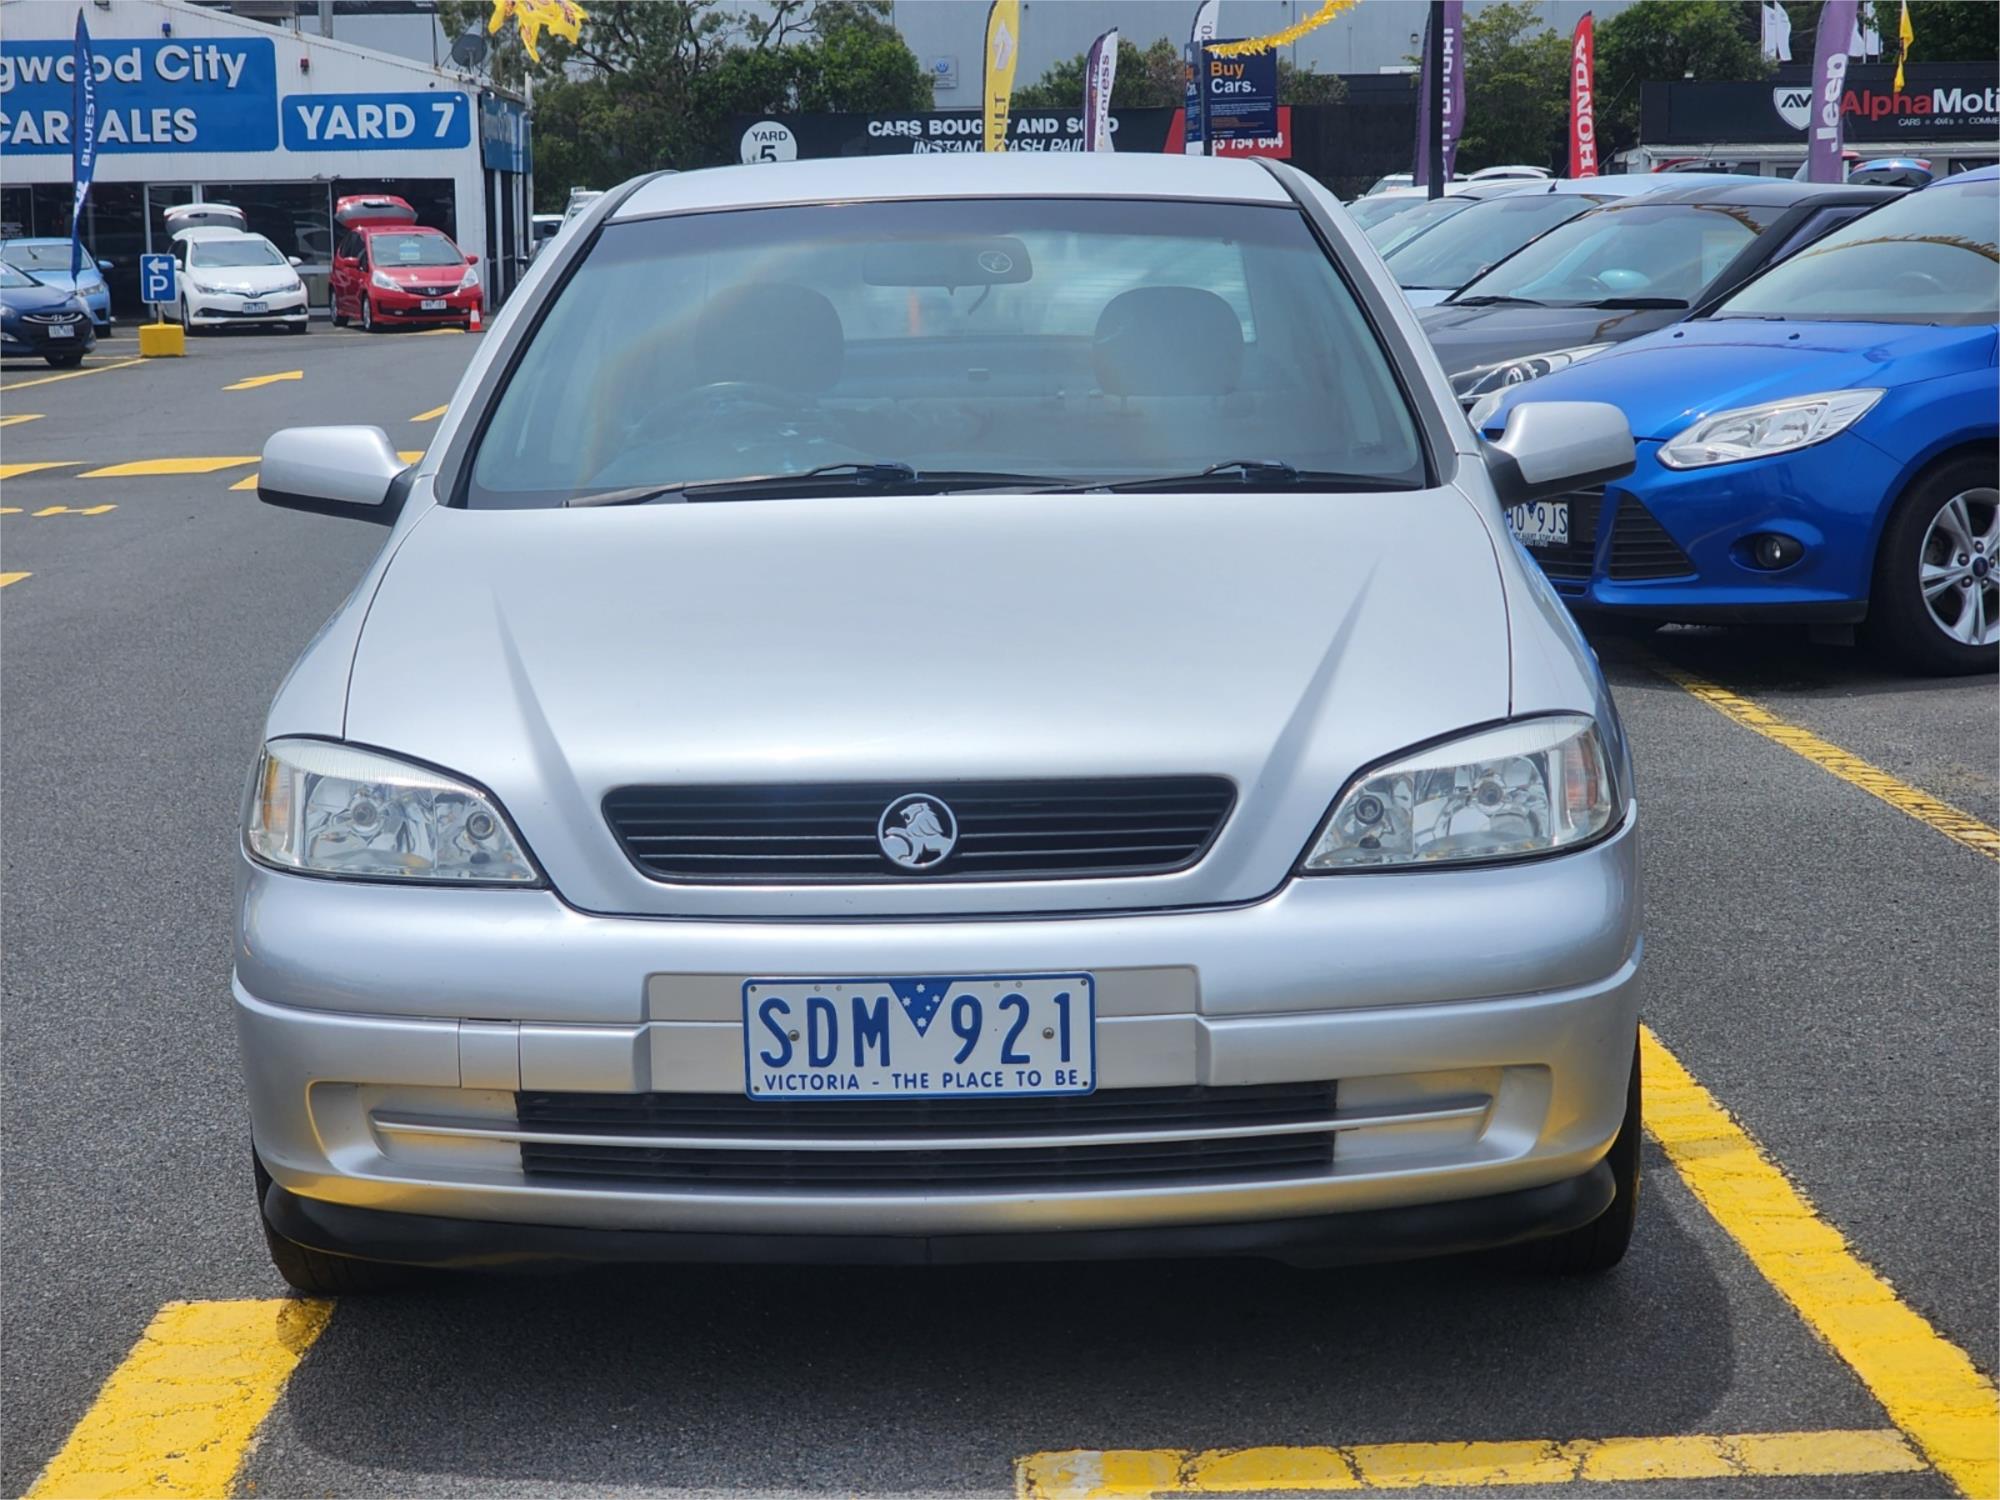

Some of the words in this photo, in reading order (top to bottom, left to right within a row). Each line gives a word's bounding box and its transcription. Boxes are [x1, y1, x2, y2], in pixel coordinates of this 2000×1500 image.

[155, 45, 247, 89] City
[1210, 61, 1245, 79] Buy
[1210, 78, 1257, 94] Cars.
[80, 48, 97, 167] BLUESTO
[1575, 34, 1595, 170] HONDA
[296, 103, 417, 141] YARD
[431, 102, 456, 138] 7
[868, 119, 922, 136] CARS
[928, 117, 1012, 135] BOUG
[1016, 118, 1059, 134] AND
[751, 130, 788, 142] YARD
[1004, 138, 1046, 152] ASH
[760, 144, 777, 163] 5
[150, 275, 169, 299] P
[1537, 506, 1568, 534] 9JS
[759, 996, 891, 1068] SDM
[951, 992, 1071, 1065] 921
[764, 1074, 861, 1091] VICTORIA
[892, 1073, 930, 1089] THE
[943, 1070, 1004, 1089] PLACE
[1016, 1070, 1043, 1087] TO
[1055, 1069, 1078, 1086] BE
